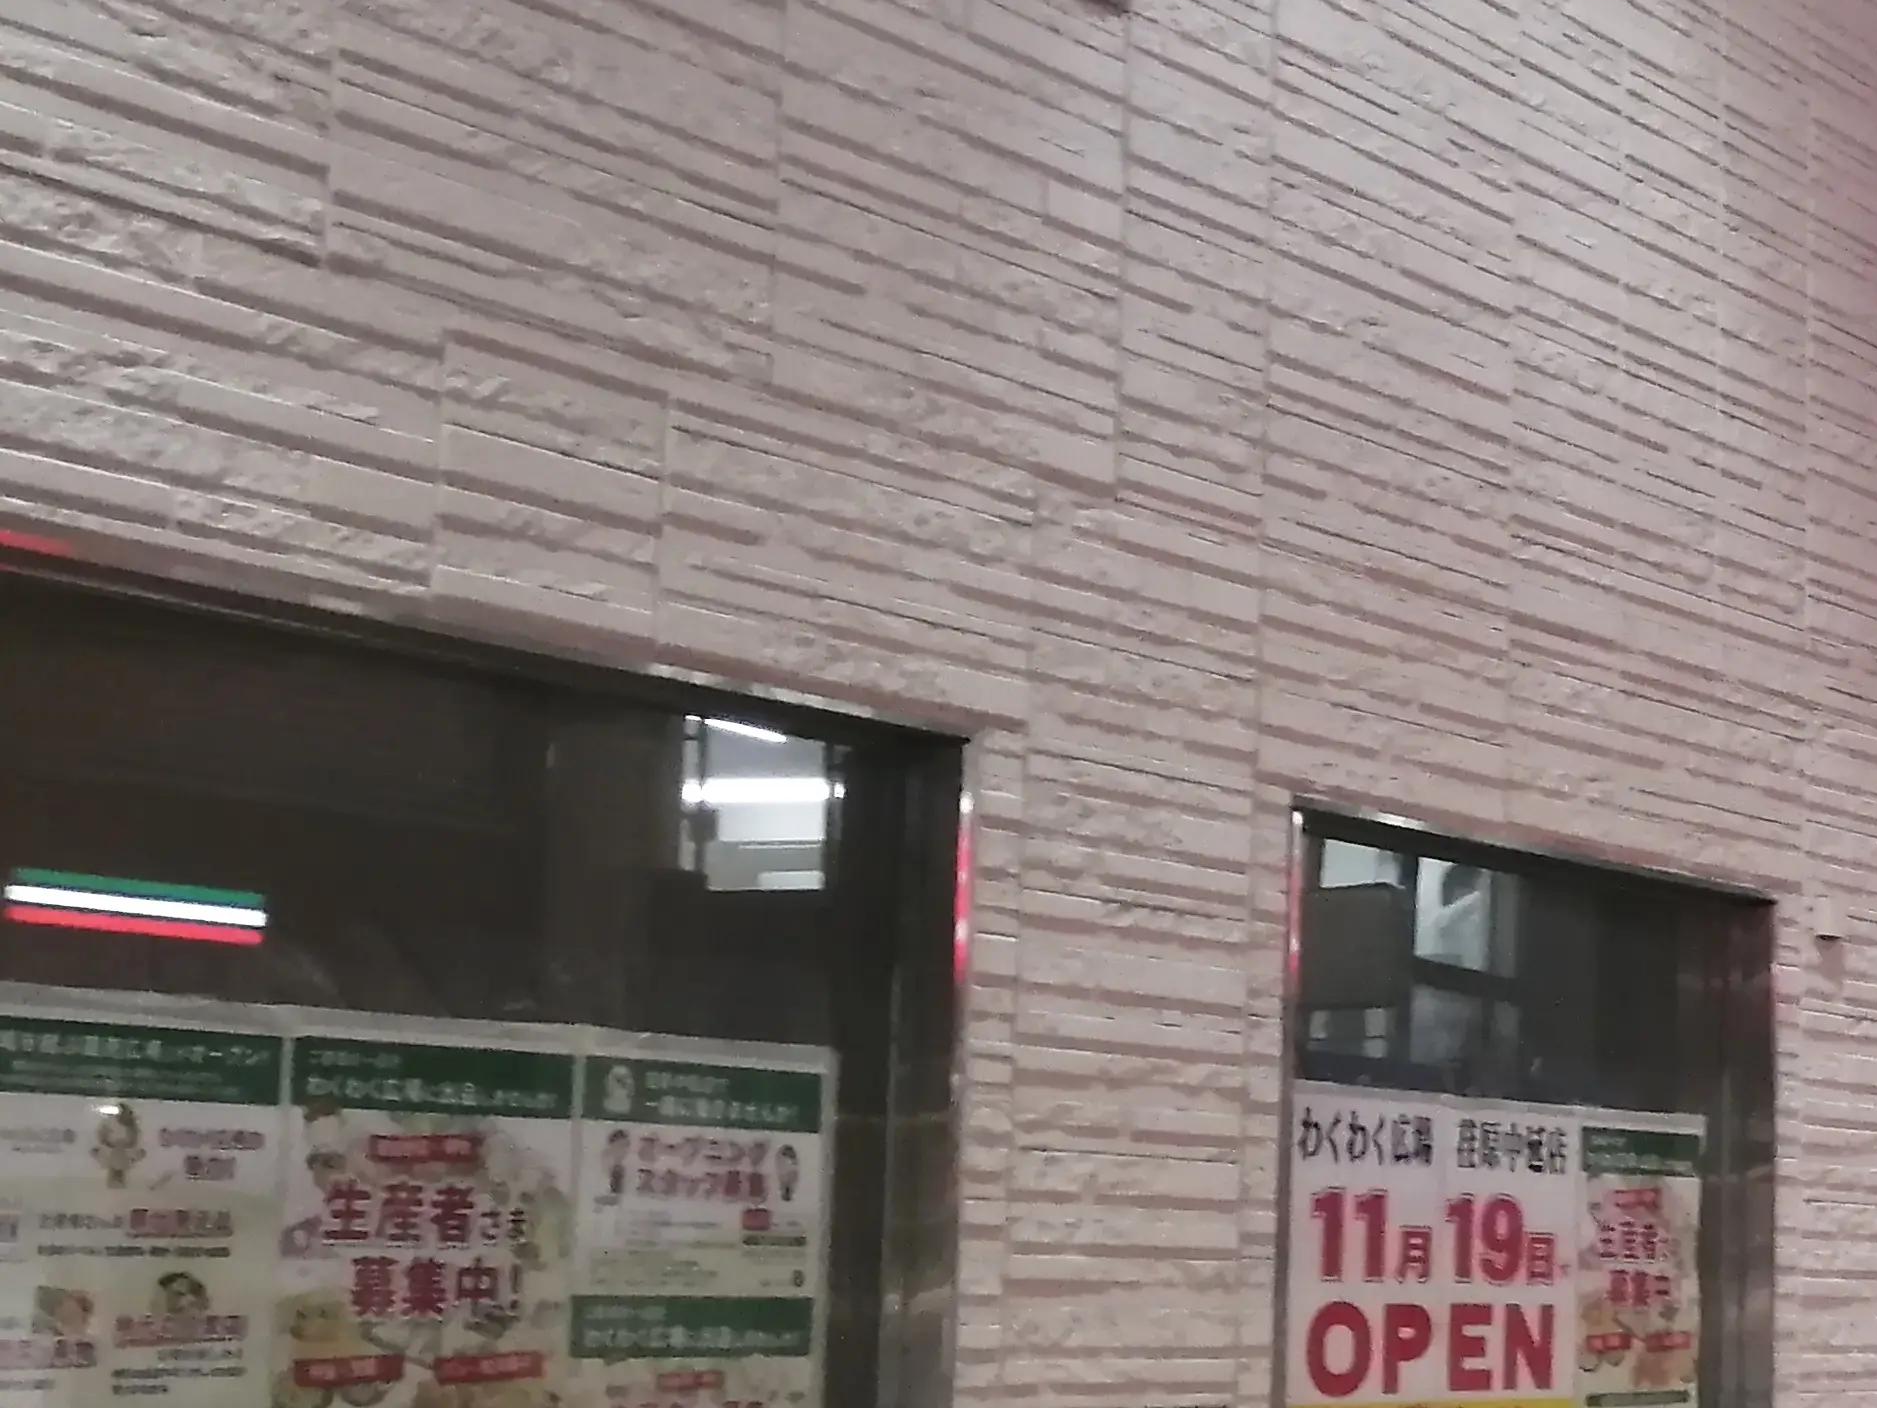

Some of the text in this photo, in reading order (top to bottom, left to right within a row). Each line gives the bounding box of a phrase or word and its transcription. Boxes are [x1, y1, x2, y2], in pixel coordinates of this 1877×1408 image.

[1296, 1106, 1434, 1168] わくわく広場
[321, 1176, 528, 1250] 生産者さま
[1306, 1300, 1555, 1398] OPEN
